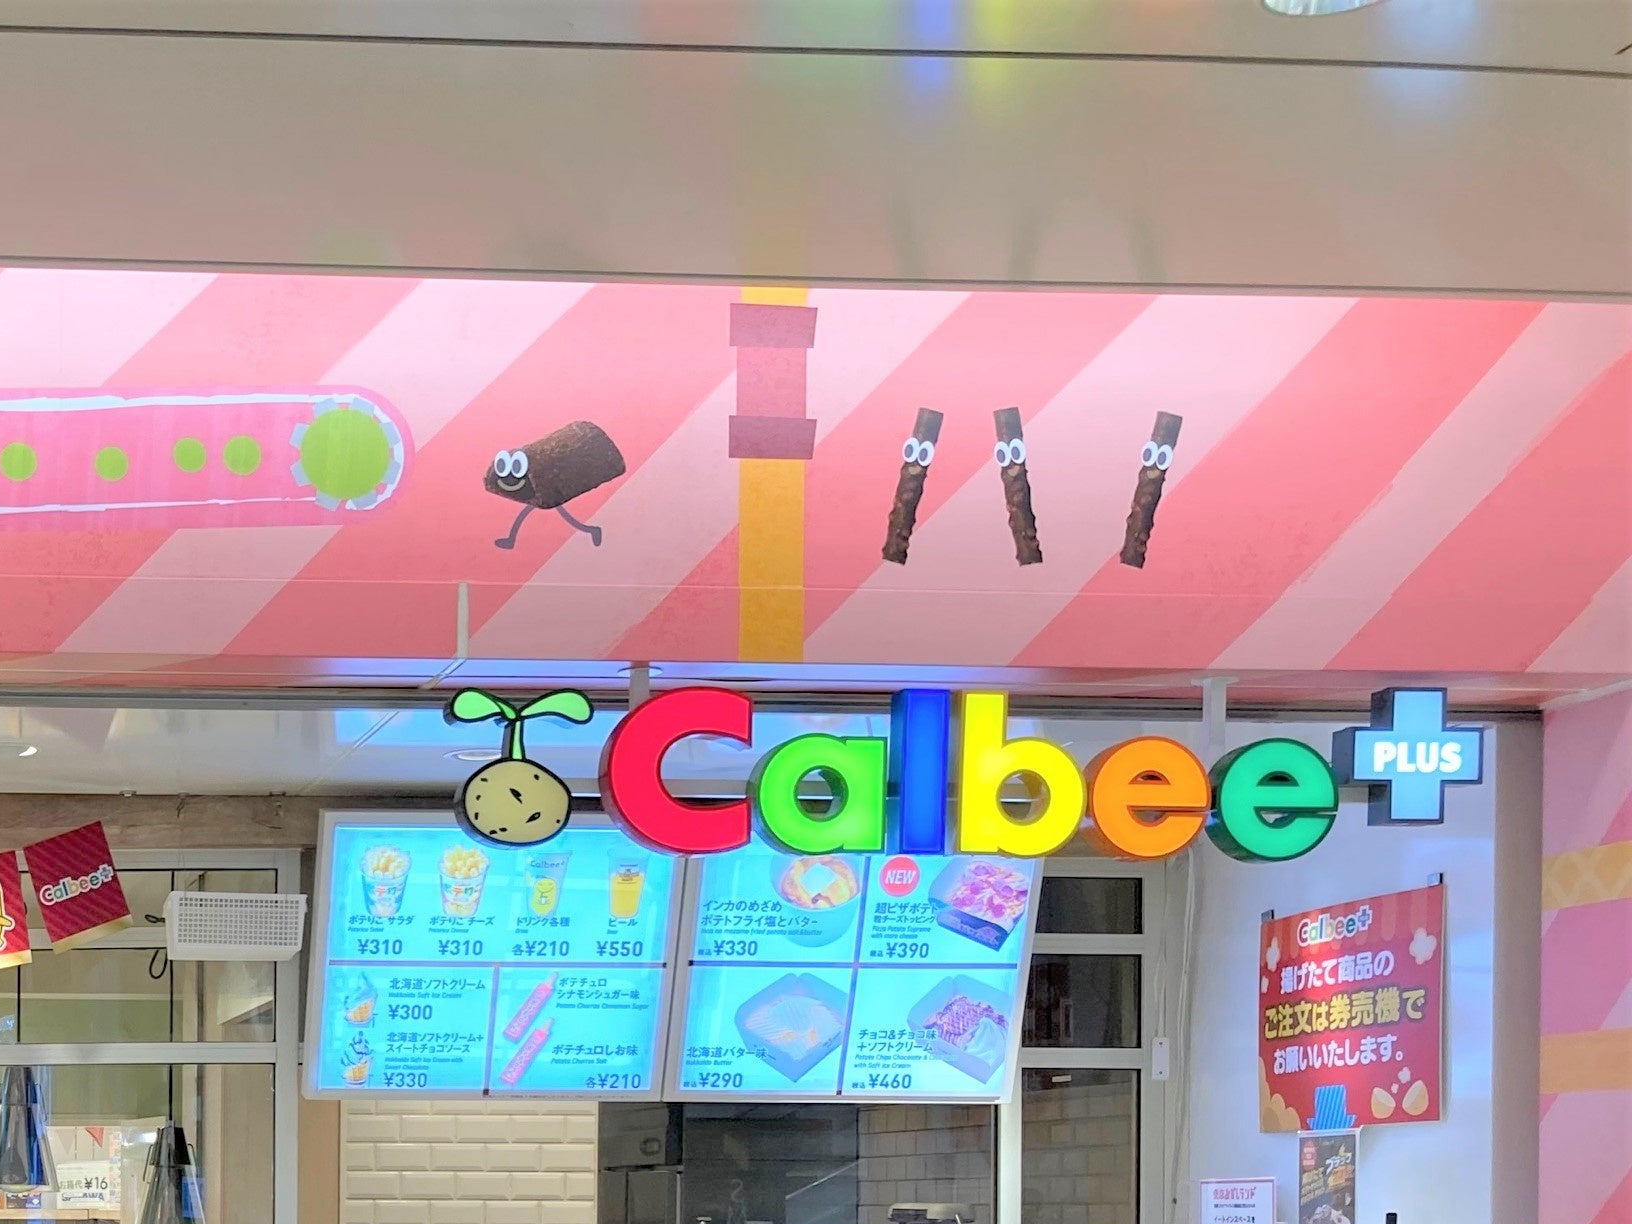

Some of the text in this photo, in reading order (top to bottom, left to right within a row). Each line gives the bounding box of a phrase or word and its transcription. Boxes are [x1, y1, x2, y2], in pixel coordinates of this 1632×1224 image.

[600, 684, 1464, 861] Calbee PLUS
[884, 869, 917, 885] NEW
[702, 899, 783, 912] インカのめざめ
[874, 902, 938, 914] 超ピザポテト
[468, 916, 495, 926] チーズ
[609, 918, 639, 928] ビール
[700, 914, 818, 928] ポテトフライ塩とバター
[357, 938, 403, 956] ¥310
[438, 939, 484, 956] ¥310
[512, 940, 570, 957] 各¥210
[596, 940, 644, 957] ¥550
[713, 939, 758, 956] ¥330
[886, 942, 930, 959] ¥390
[1279, 950, 1395, 995] 揚げたて商品の
[389, 977, 486, 990] 北海道ソフトクリーム
[559, 977, 608, 988] ポテチュロ
[556, 989, 640, 1000] シナモンシュガー味
[388, 1004, 433, 1020] ¥300
[1263, 986, 1427, 1040] ご注文は券売機で
[858, 1029, 937, 1040] チョコ&チョコ味
[385, 1043, 471, 1054] スイートチョコソース
[552, 1044, 639, 1056] ポテチュロしお味
[1272, 1033, 1405, 1076] お願いいたします。
[383, 1072, 428, 1088] ¥330
[585, 1073, 642, 1089] 各¥210
[698, 1072, 743, 1089] ¥290
[868, 1073, 912, 1089] ¥460
